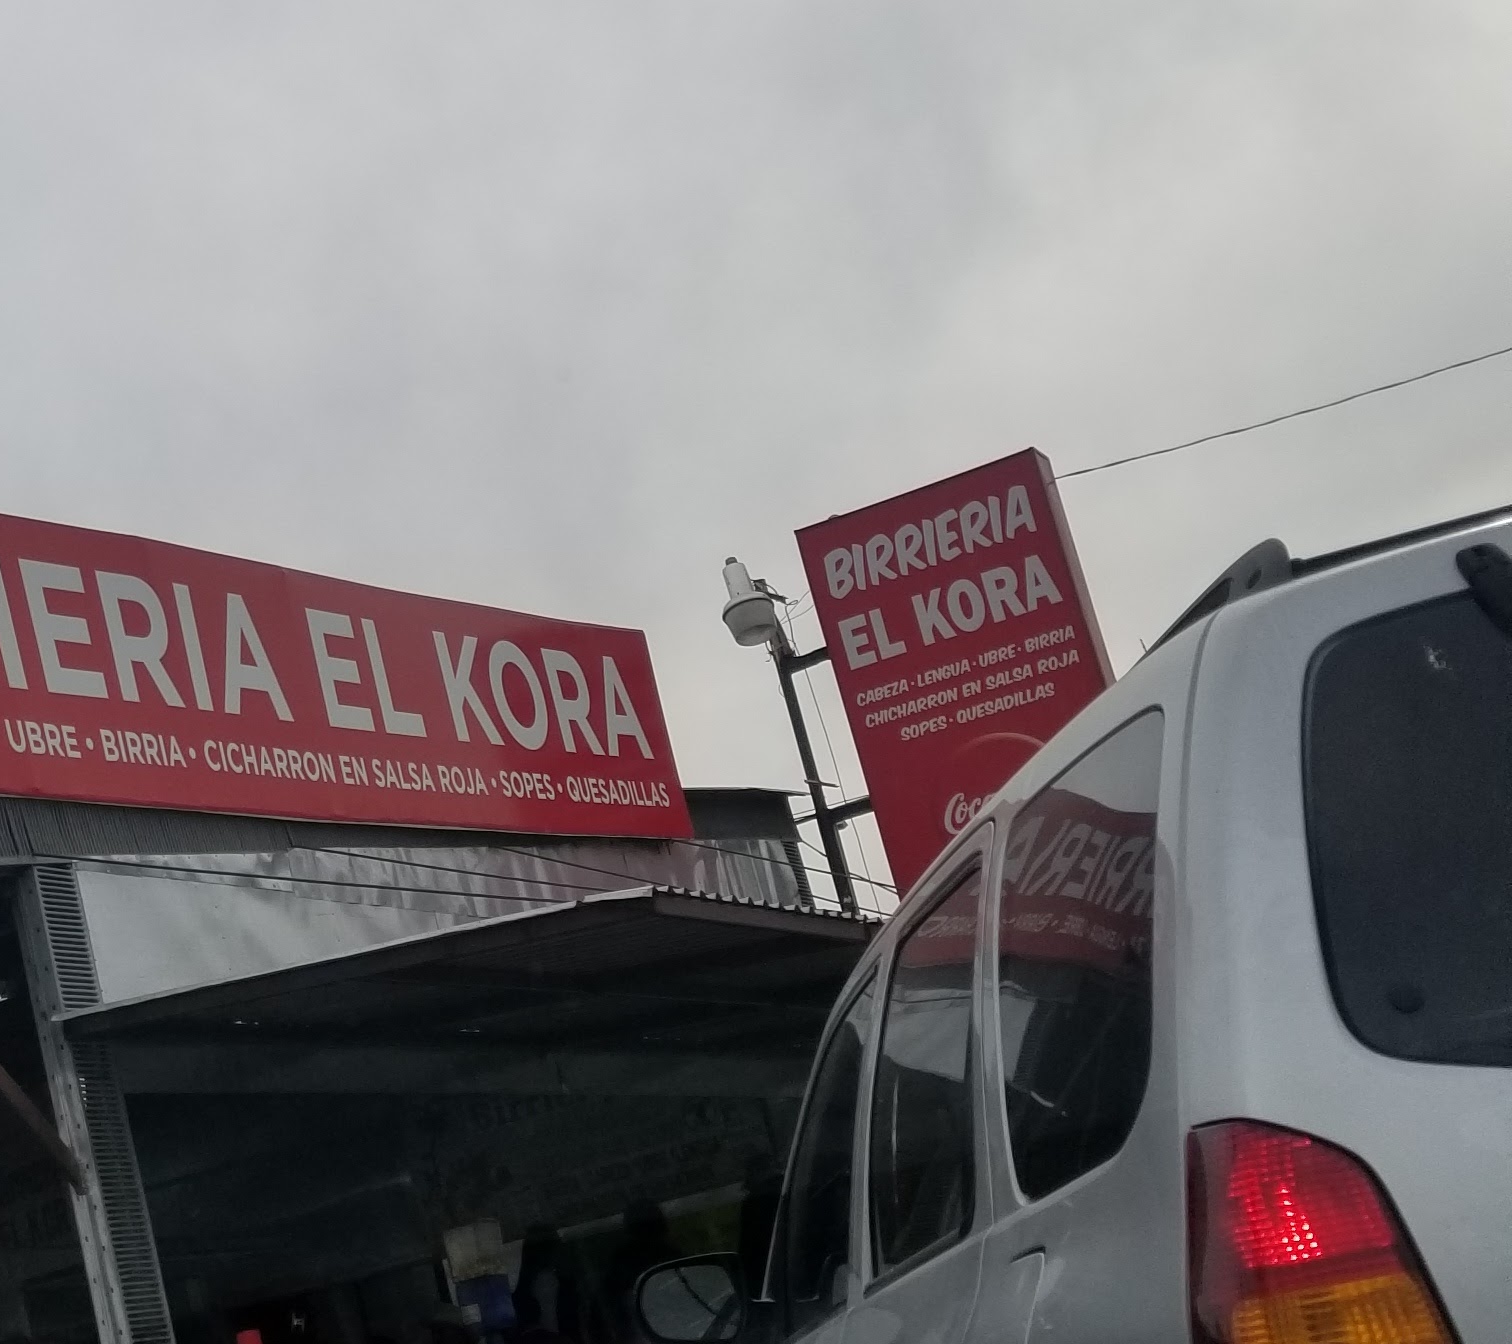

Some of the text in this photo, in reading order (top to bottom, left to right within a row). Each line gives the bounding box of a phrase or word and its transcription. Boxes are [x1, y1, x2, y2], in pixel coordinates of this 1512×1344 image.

[823, 485, 1037, 599] BIRRIERIA
[838, 554, 1063, 670] EL KORA
[305, 607, 426, 737] EL
[432, 630, 653, 758] KORA
[857, 626, 1074, 706] CABEZA LENGUA UBRE BIRRIA
[866, 650, 1078, 727] CHICHARRON EN SALSA ROJA
[901, 683, 1054, 739] SOPES QUESADILLAS
[5, 720, 81, 758] UBRE
[100, 729, 186, 766] BIRRIA
[204, 740, 335, 782] CICHARRON
[339, 755, 368, 785] EN
[372, 759, 435, 791] SALSA
[437, 765, 488, 794] ROJA
[500, 771, 555, 799] SOPES
[567, 777, 669, 806] QUESADILLAS
